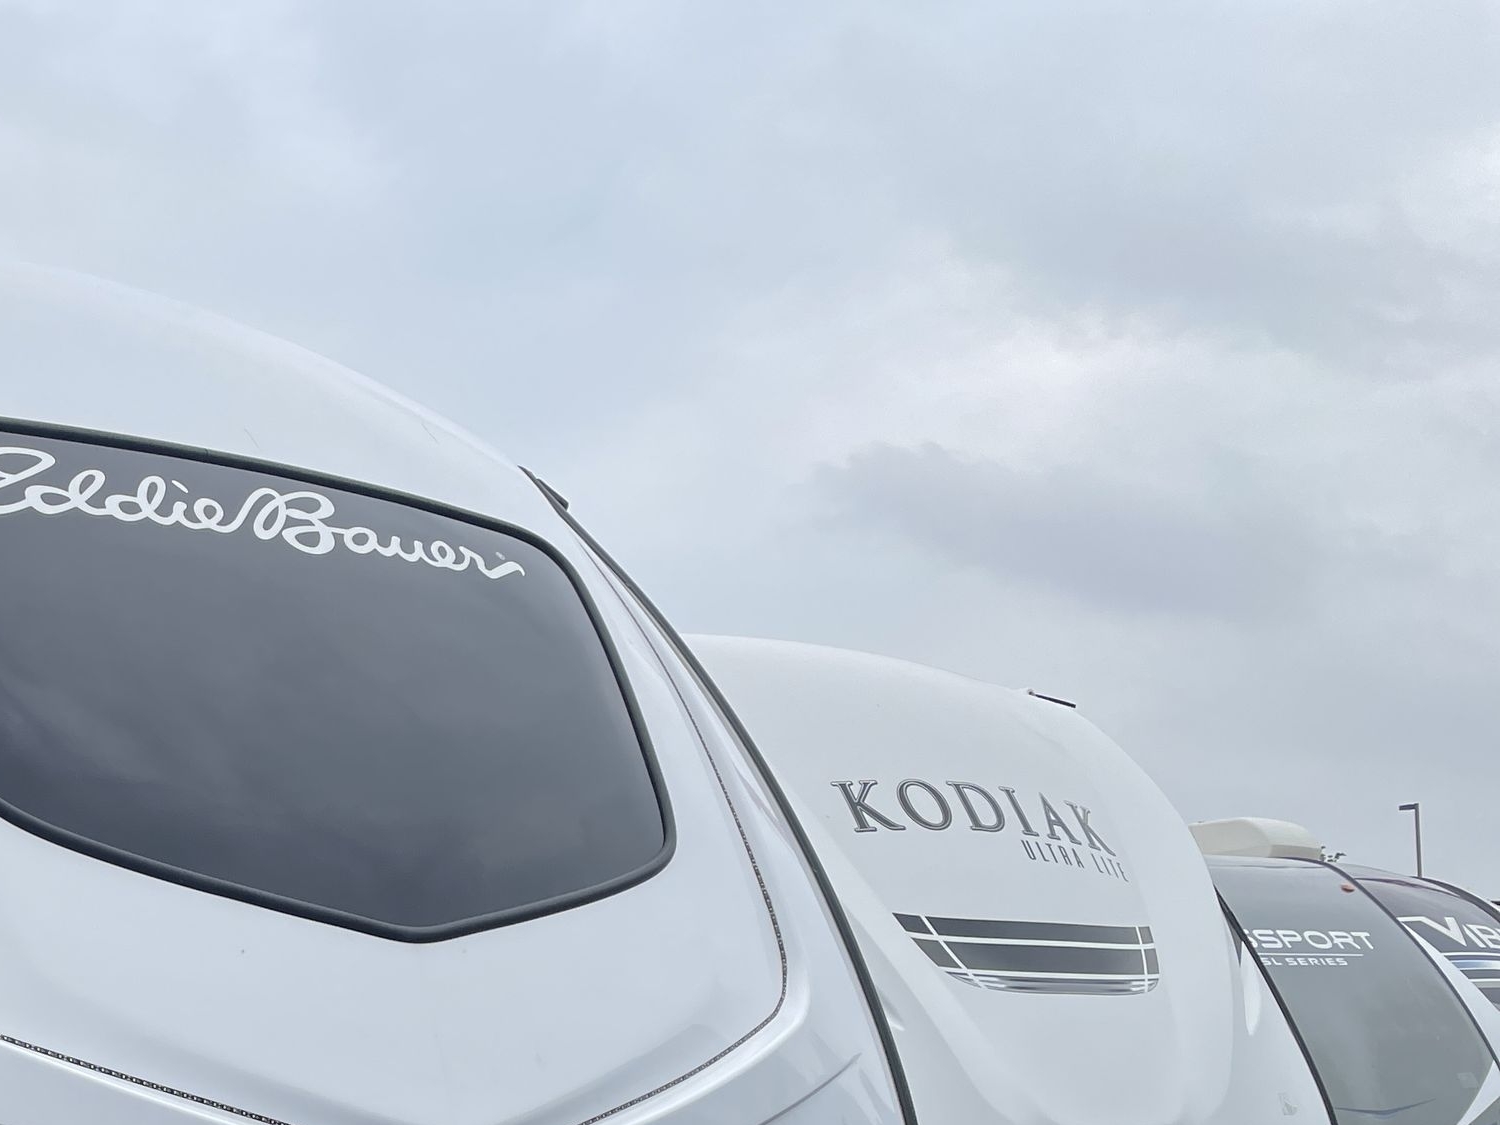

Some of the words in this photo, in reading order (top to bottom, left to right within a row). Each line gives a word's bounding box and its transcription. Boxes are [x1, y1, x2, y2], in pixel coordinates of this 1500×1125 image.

[248, 486, 526, 580] Bauer
[830, 778, 1117, 857] KODIAK
[1021, 839, 1084, 869] ULTRA
[1090, 852, 1130, 883] LITE
[1396, 915, 1500, 949] VIB
[1285, 957, 1349, 966] SERIES
